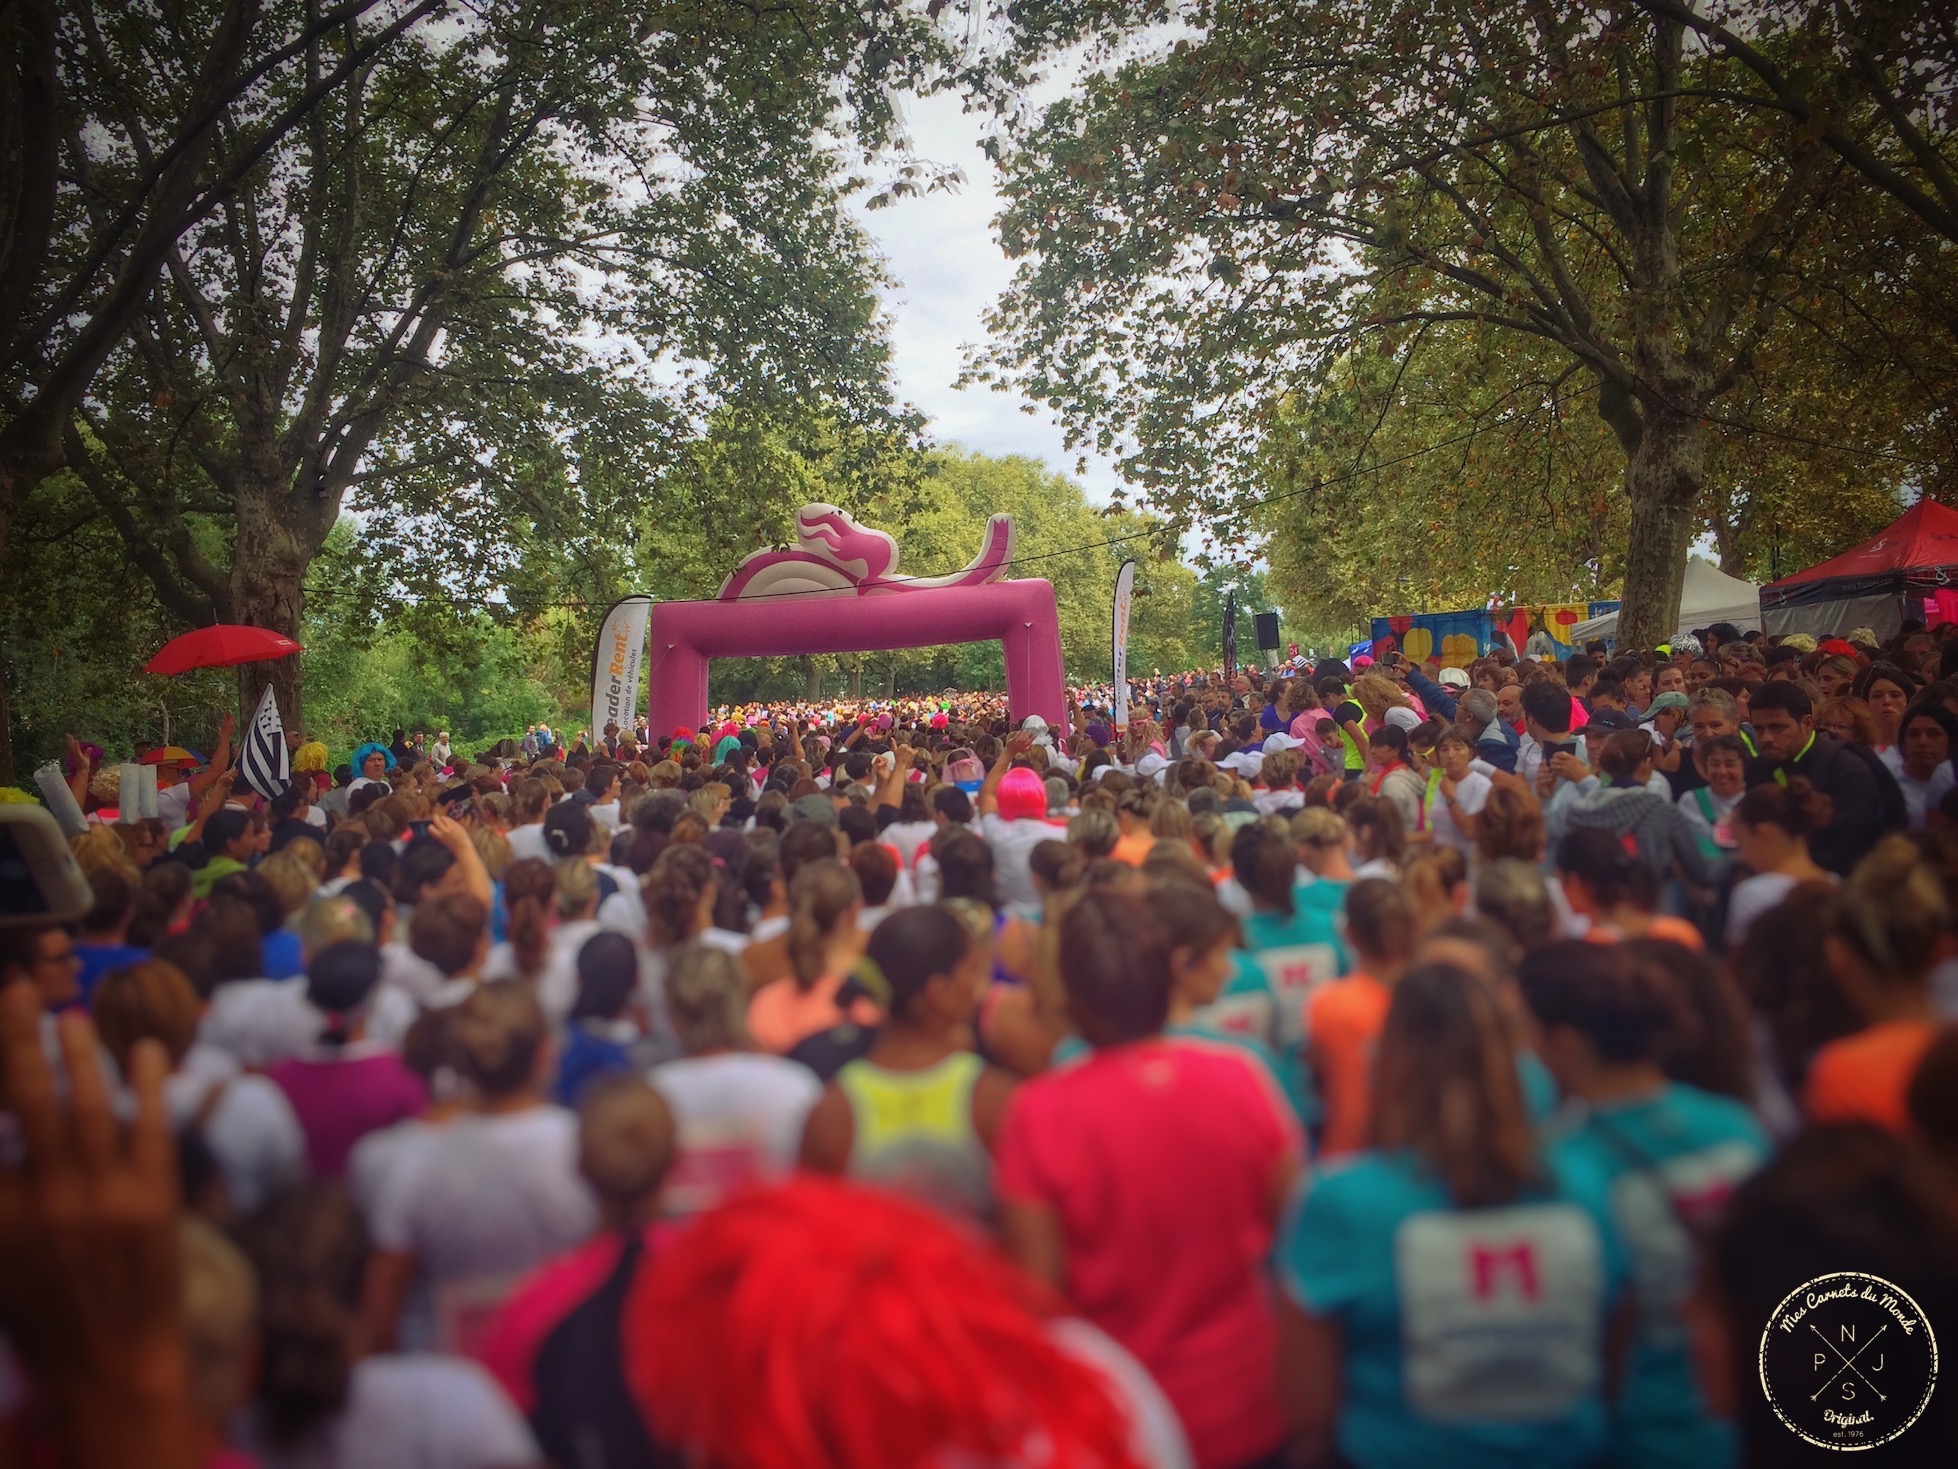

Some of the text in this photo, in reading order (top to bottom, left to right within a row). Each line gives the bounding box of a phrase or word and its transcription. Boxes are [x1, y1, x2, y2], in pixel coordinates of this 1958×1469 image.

[605, 632, 630, 726] eaderRent
[621, 649, 638, 730] Location de véhicules
